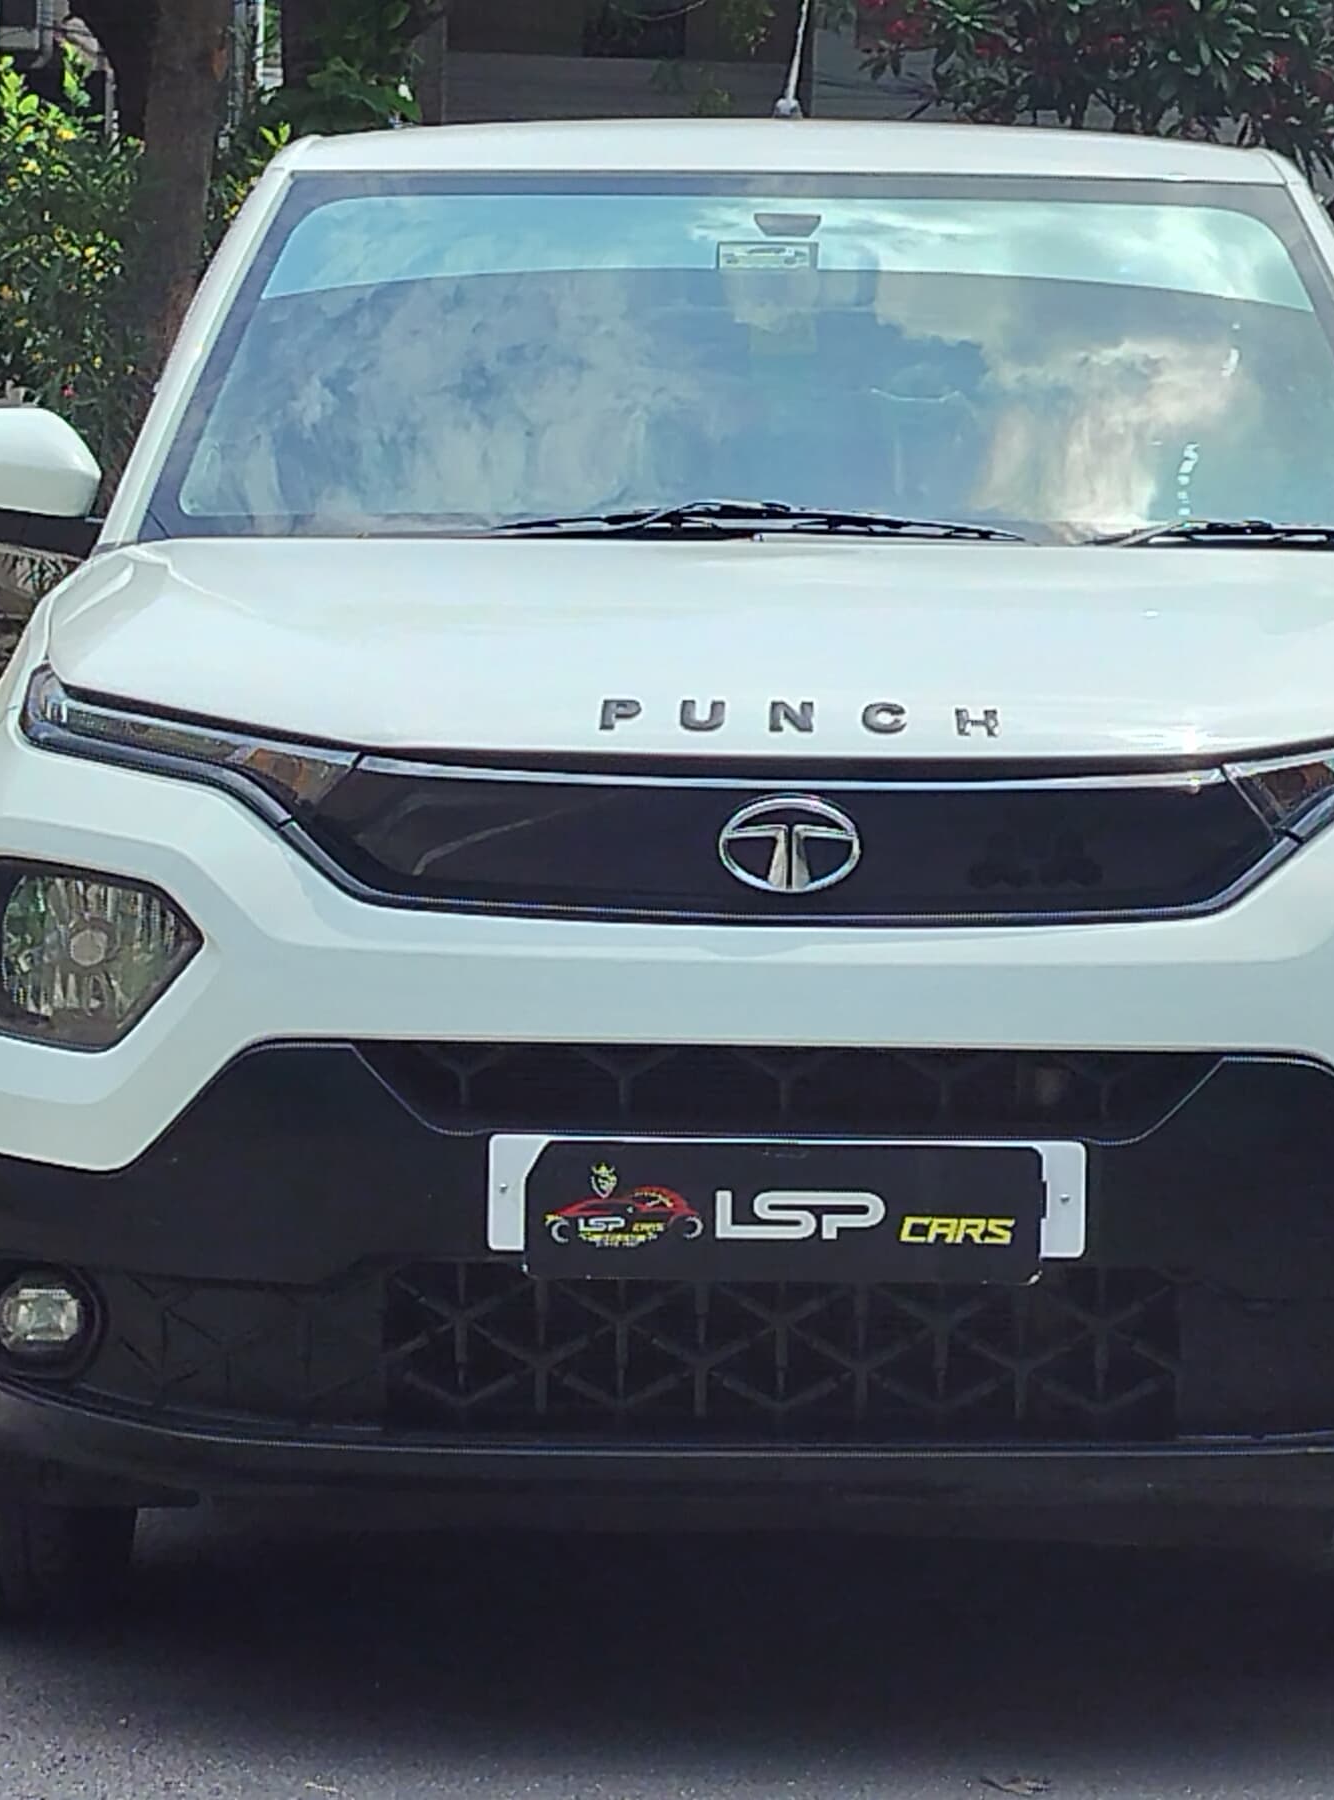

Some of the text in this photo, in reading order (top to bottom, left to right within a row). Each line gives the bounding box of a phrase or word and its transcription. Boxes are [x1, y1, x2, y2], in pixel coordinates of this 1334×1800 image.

[599, 699, 1000, 737] PUNCH
[578, 1216, 626, 1232] LSP
[715, 1190, 1016, 1245] LSP CARS
